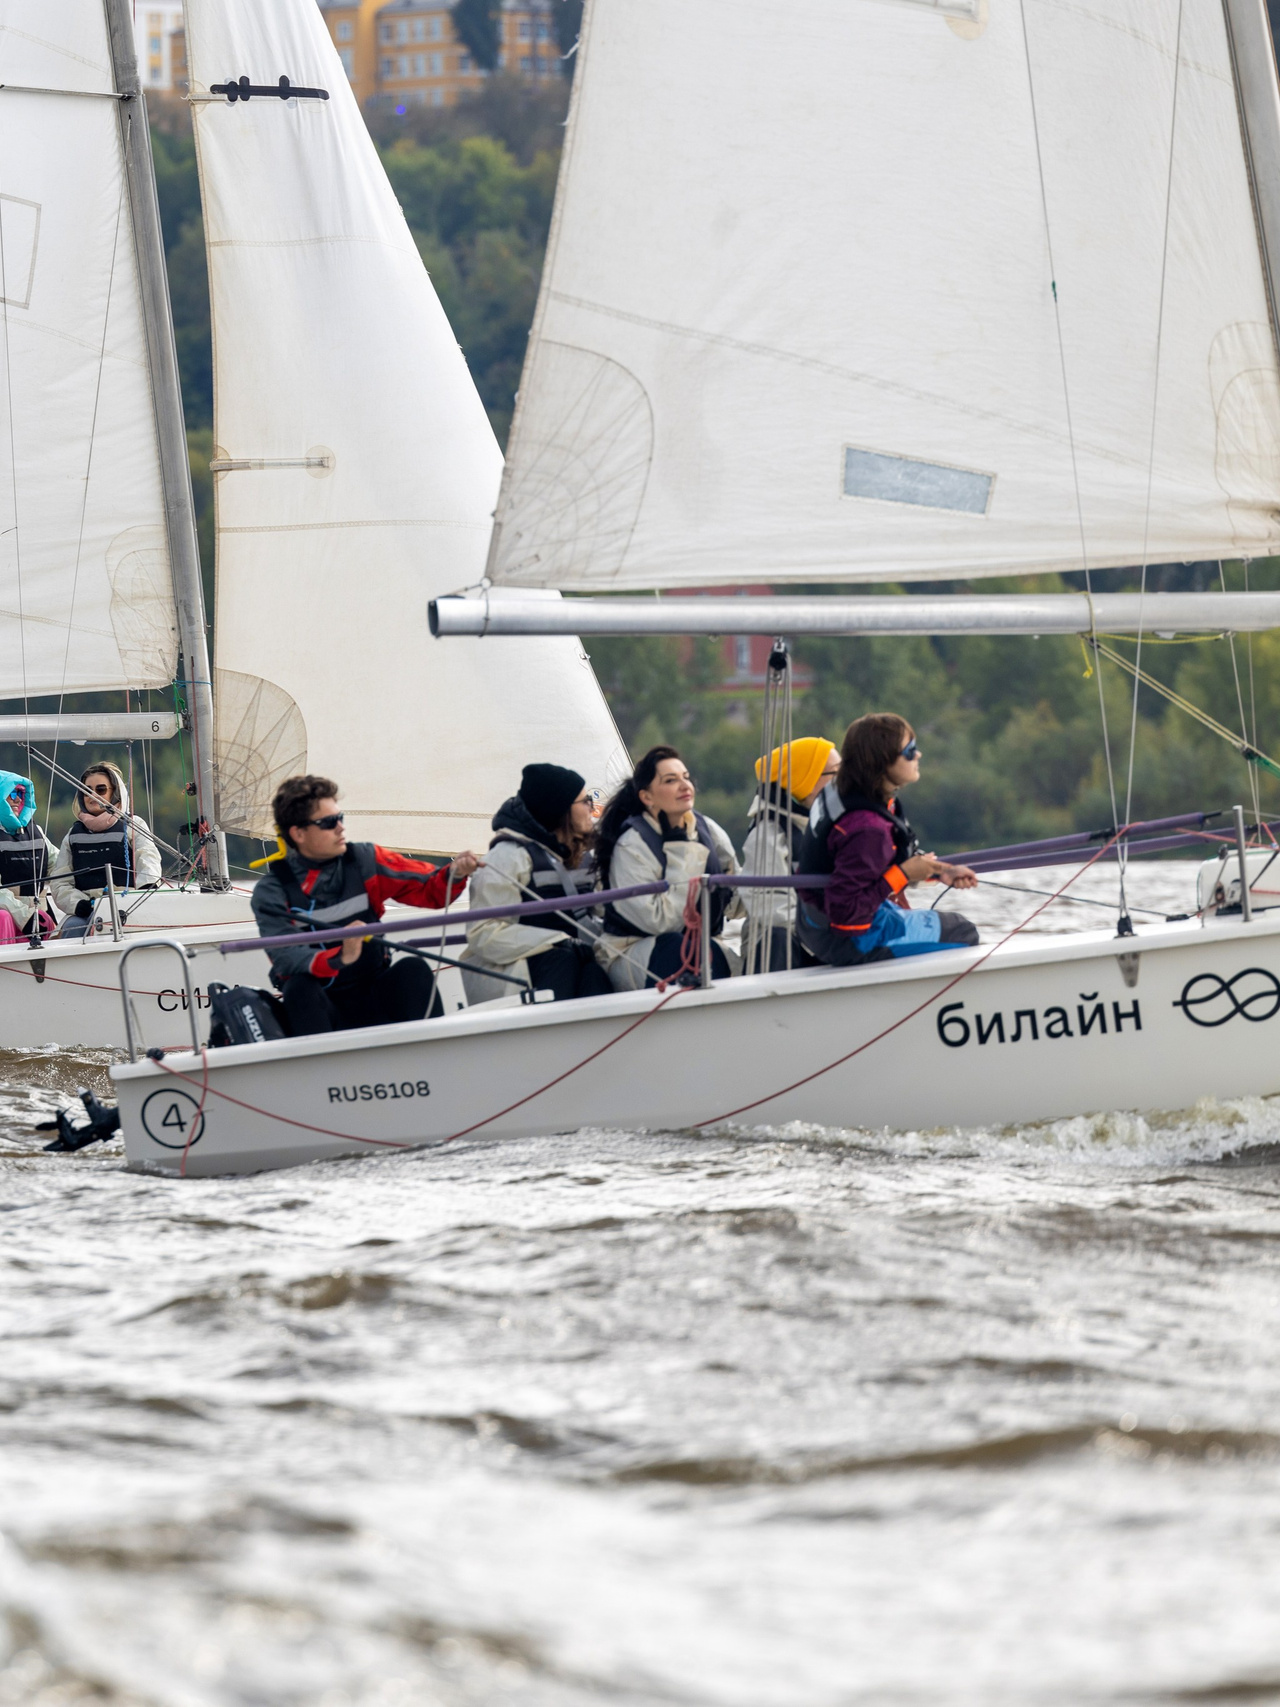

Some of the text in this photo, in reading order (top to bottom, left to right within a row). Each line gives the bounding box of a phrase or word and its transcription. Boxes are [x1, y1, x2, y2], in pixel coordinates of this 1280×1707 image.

[150, 720, 160, 733] 6
[936, 991, 1143, 1048] билайн
[327, 1080, 431, 1104] RUS6108
[161, 1103, 187, 1133] 4
